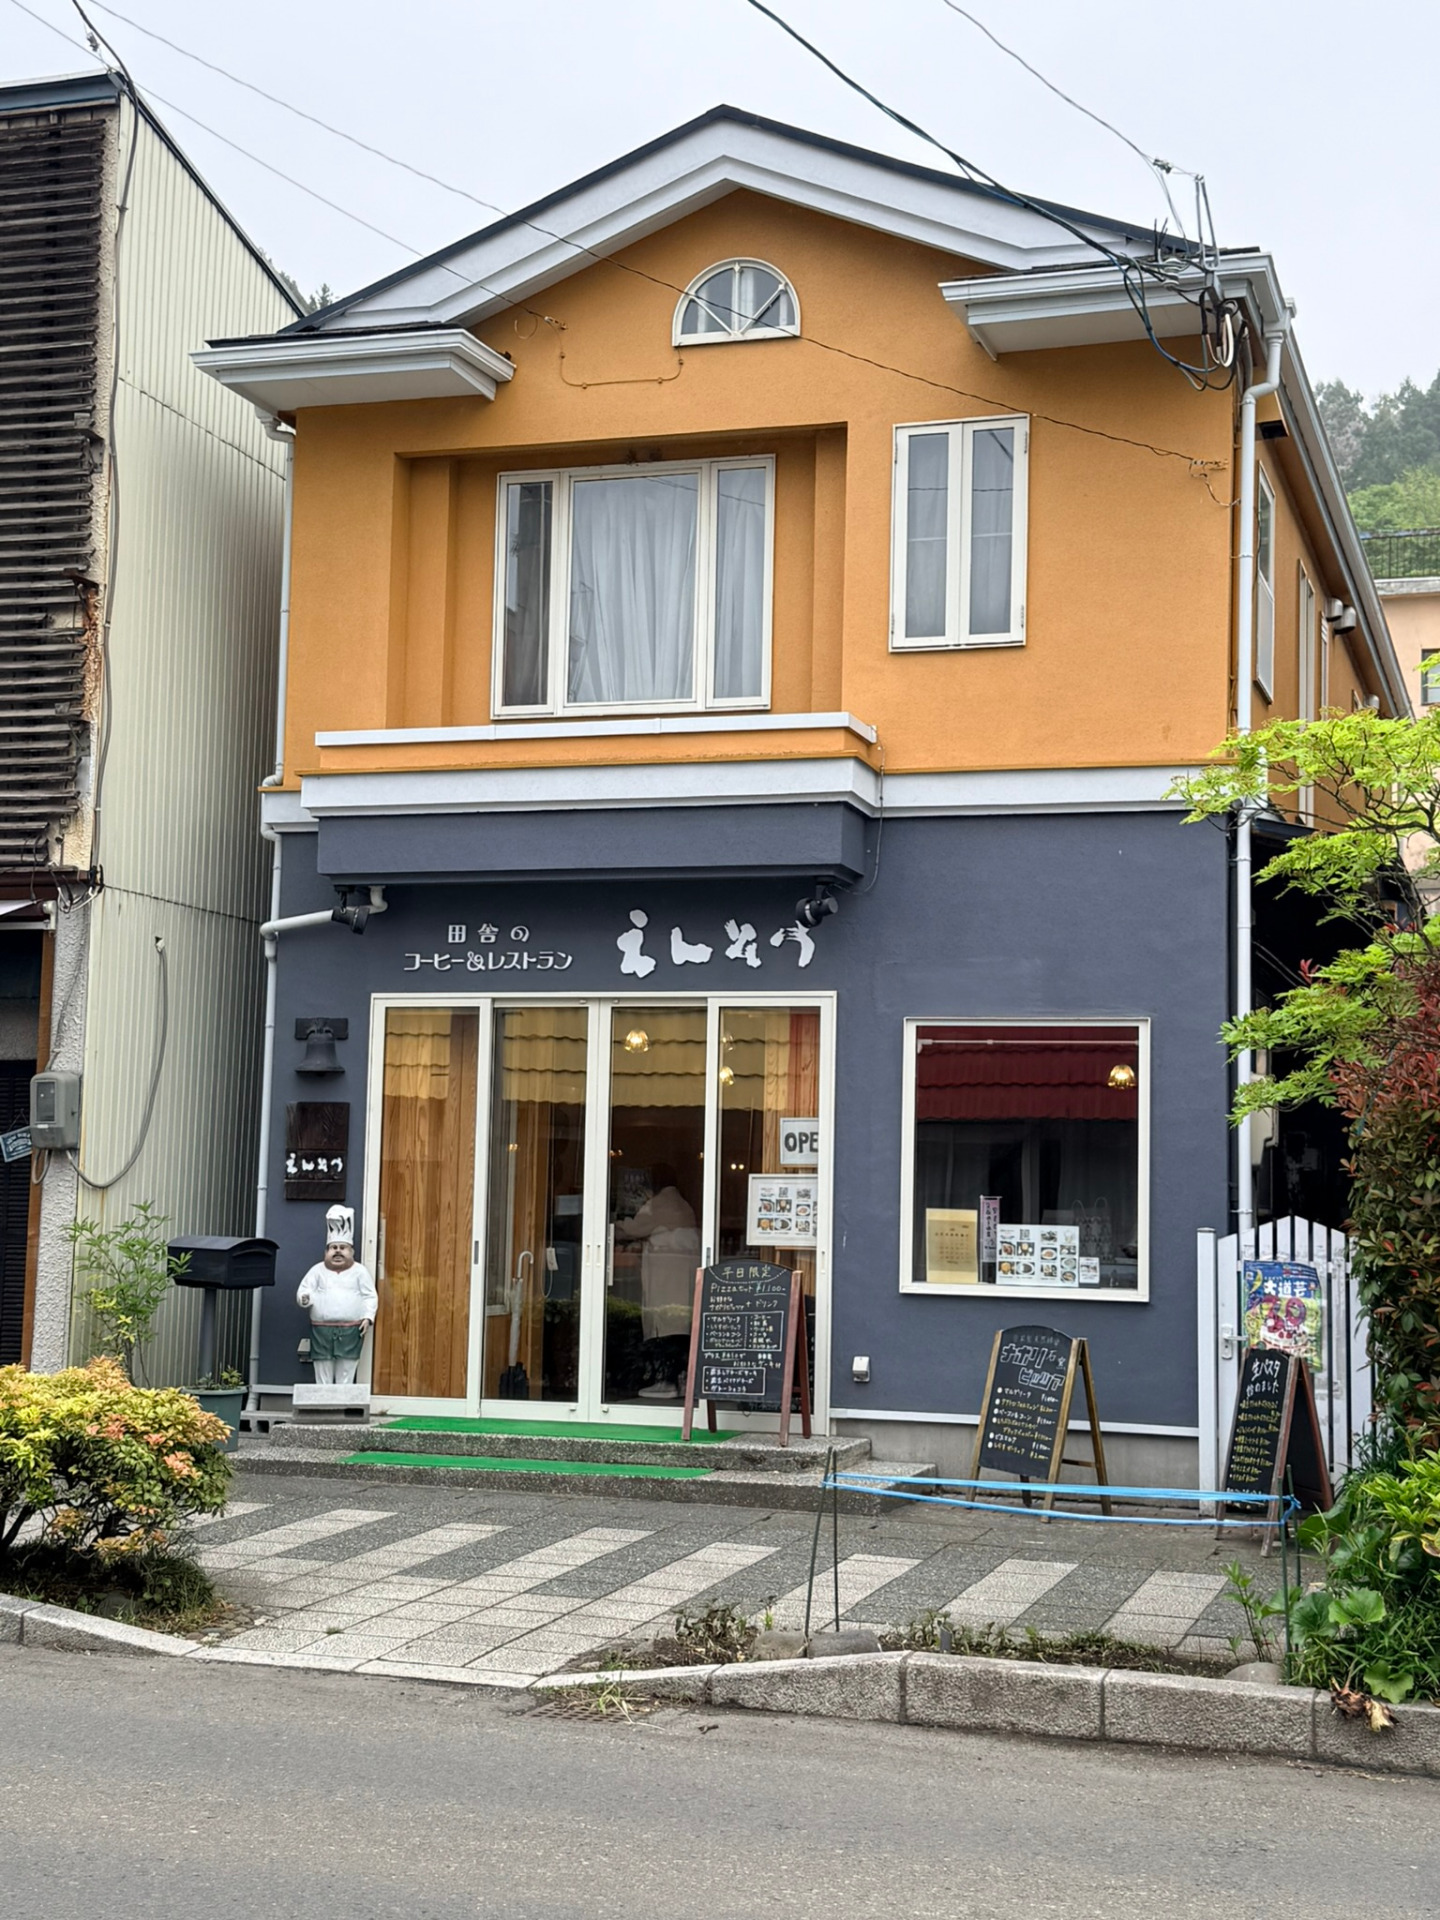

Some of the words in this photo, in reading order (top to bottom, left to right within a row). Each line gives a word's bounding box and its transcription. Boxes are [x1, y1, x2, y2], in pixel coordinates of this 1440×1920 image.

[447, 923, 531, 944] 田舎の
[403, 950, 574, 972] コーヒー&レストラン
[721, 1264, 772, 1280] 平日限定
[1263, 1279, 1307, 1298] 大道芸
